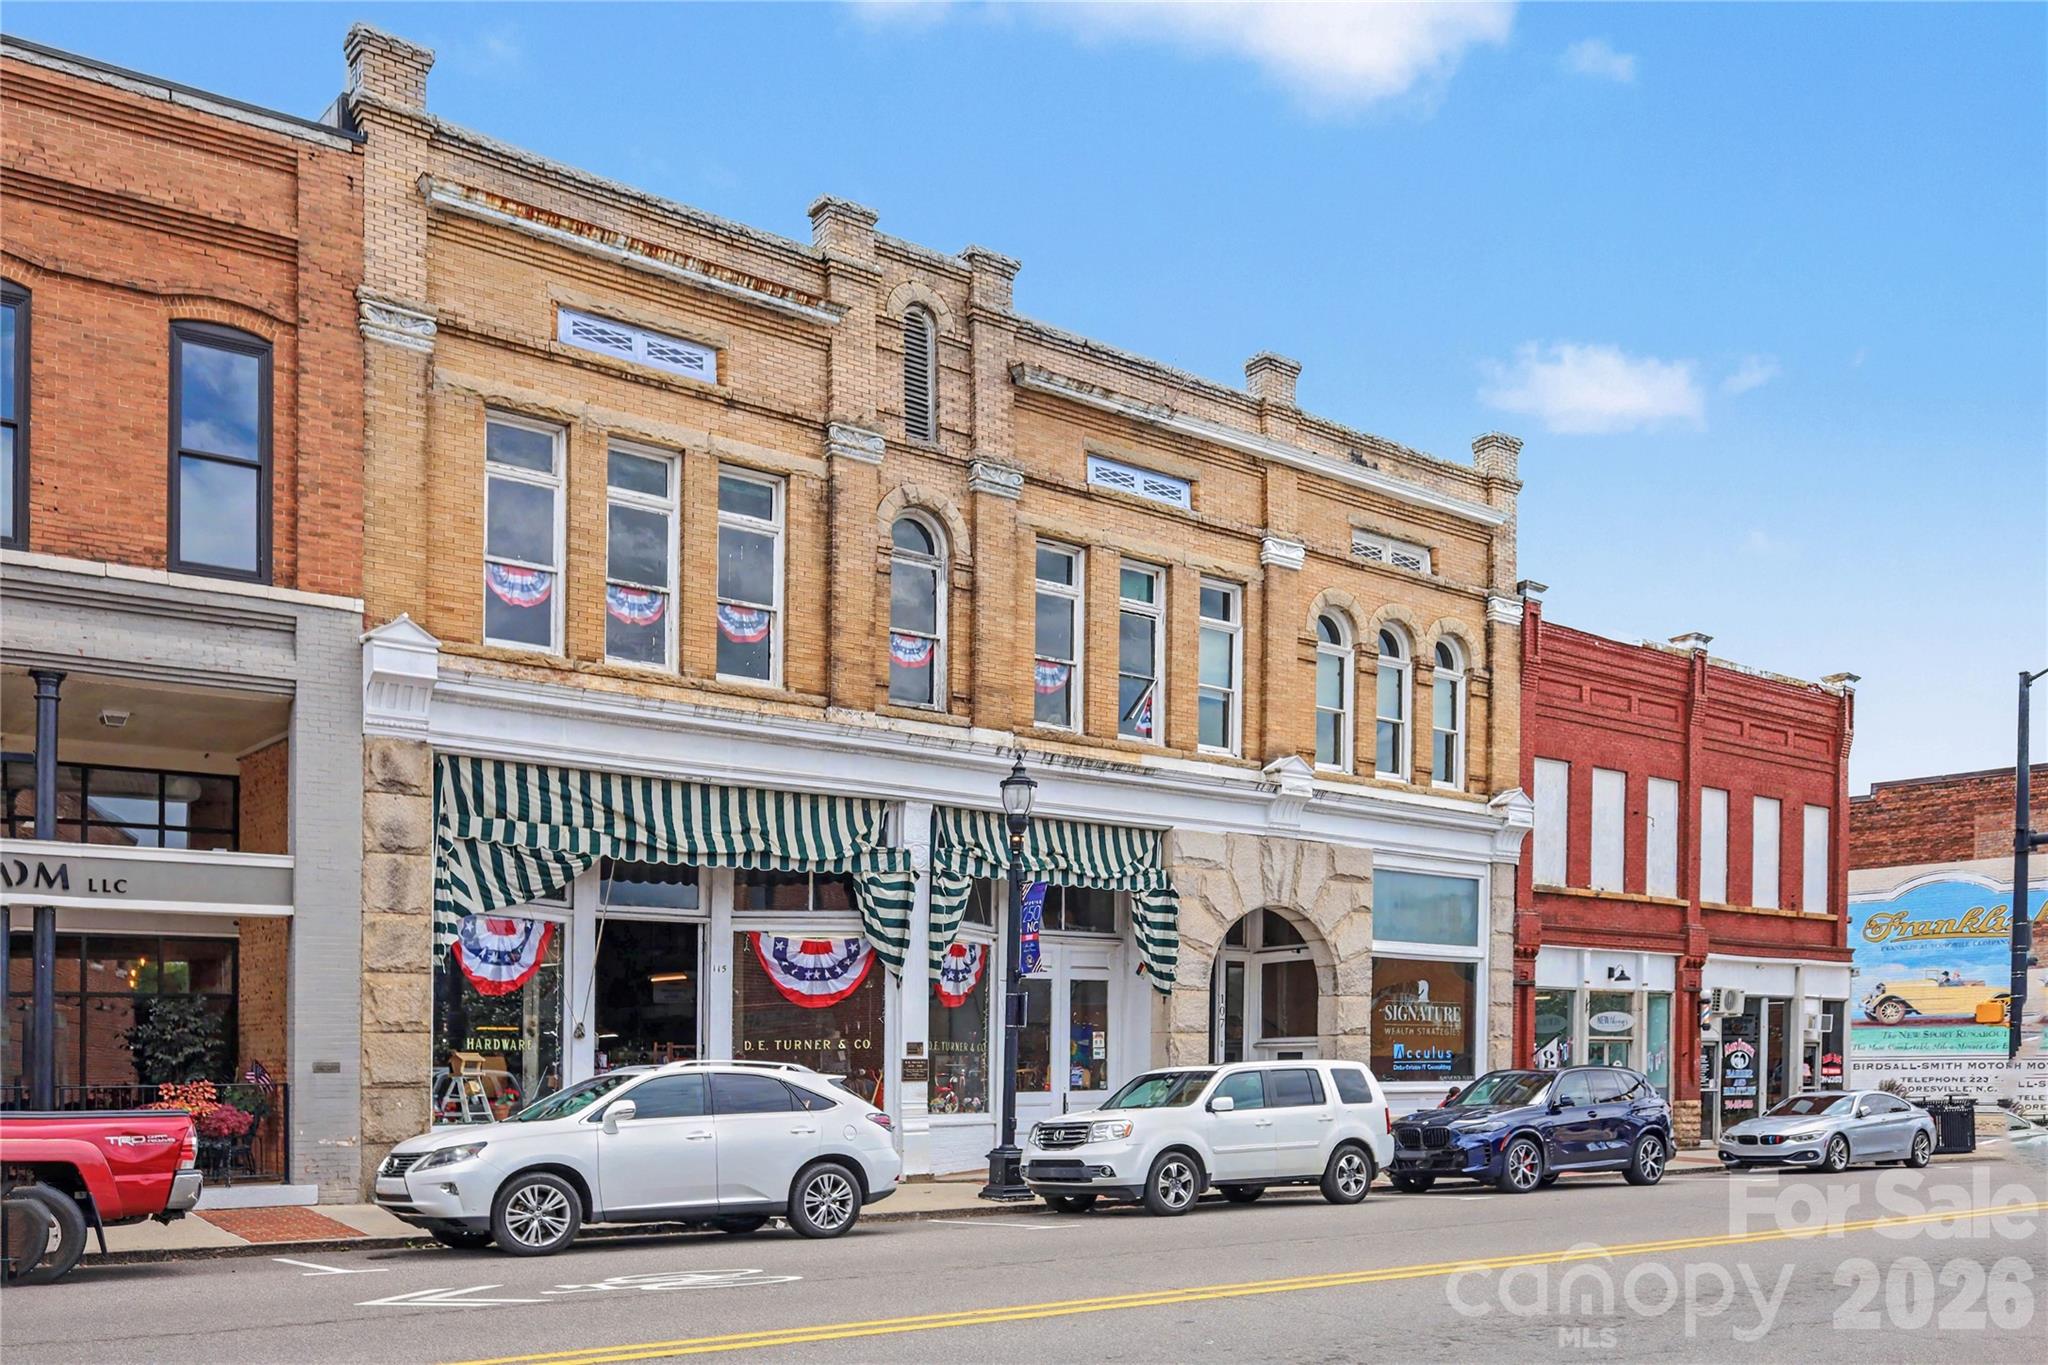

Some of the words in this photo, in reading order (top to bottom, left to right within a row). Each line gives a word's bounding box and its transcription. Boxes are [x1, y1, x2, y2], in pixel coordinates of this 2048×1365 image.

[88, 878, 127, 893] LLC
[1023, 905, 1041, 923] 250
[1027, 921, 1039, 932] NC
[1863, 905, 2013, 943] Frankli
[713, 965, 727, 973] 115
[1384, 1004, 1461, 1022] SIGNATURE
[1385, 1027, 1414, 1035] WEALTH
[466, 1038, 532, 1050] HARDWARE
[744, 1041, 754, 1050] D.
[758, 1041, 769, 1050] E.
[775, 1040, 831, 1050] TURNER
[838, 1040, 846, 1049] &
[854, 1039, 872, 1050] CO.
[942, 1041, 968, 1052] TURNER
[1393, 1043, 1453, 1059] Acculus
[1853, 1062, 1962, 1071] BIRDSALL-SMITH
[1900, 1085, 1972, 1093] OORESVILLE,
[105, 1136, 146, 1147] TRD
